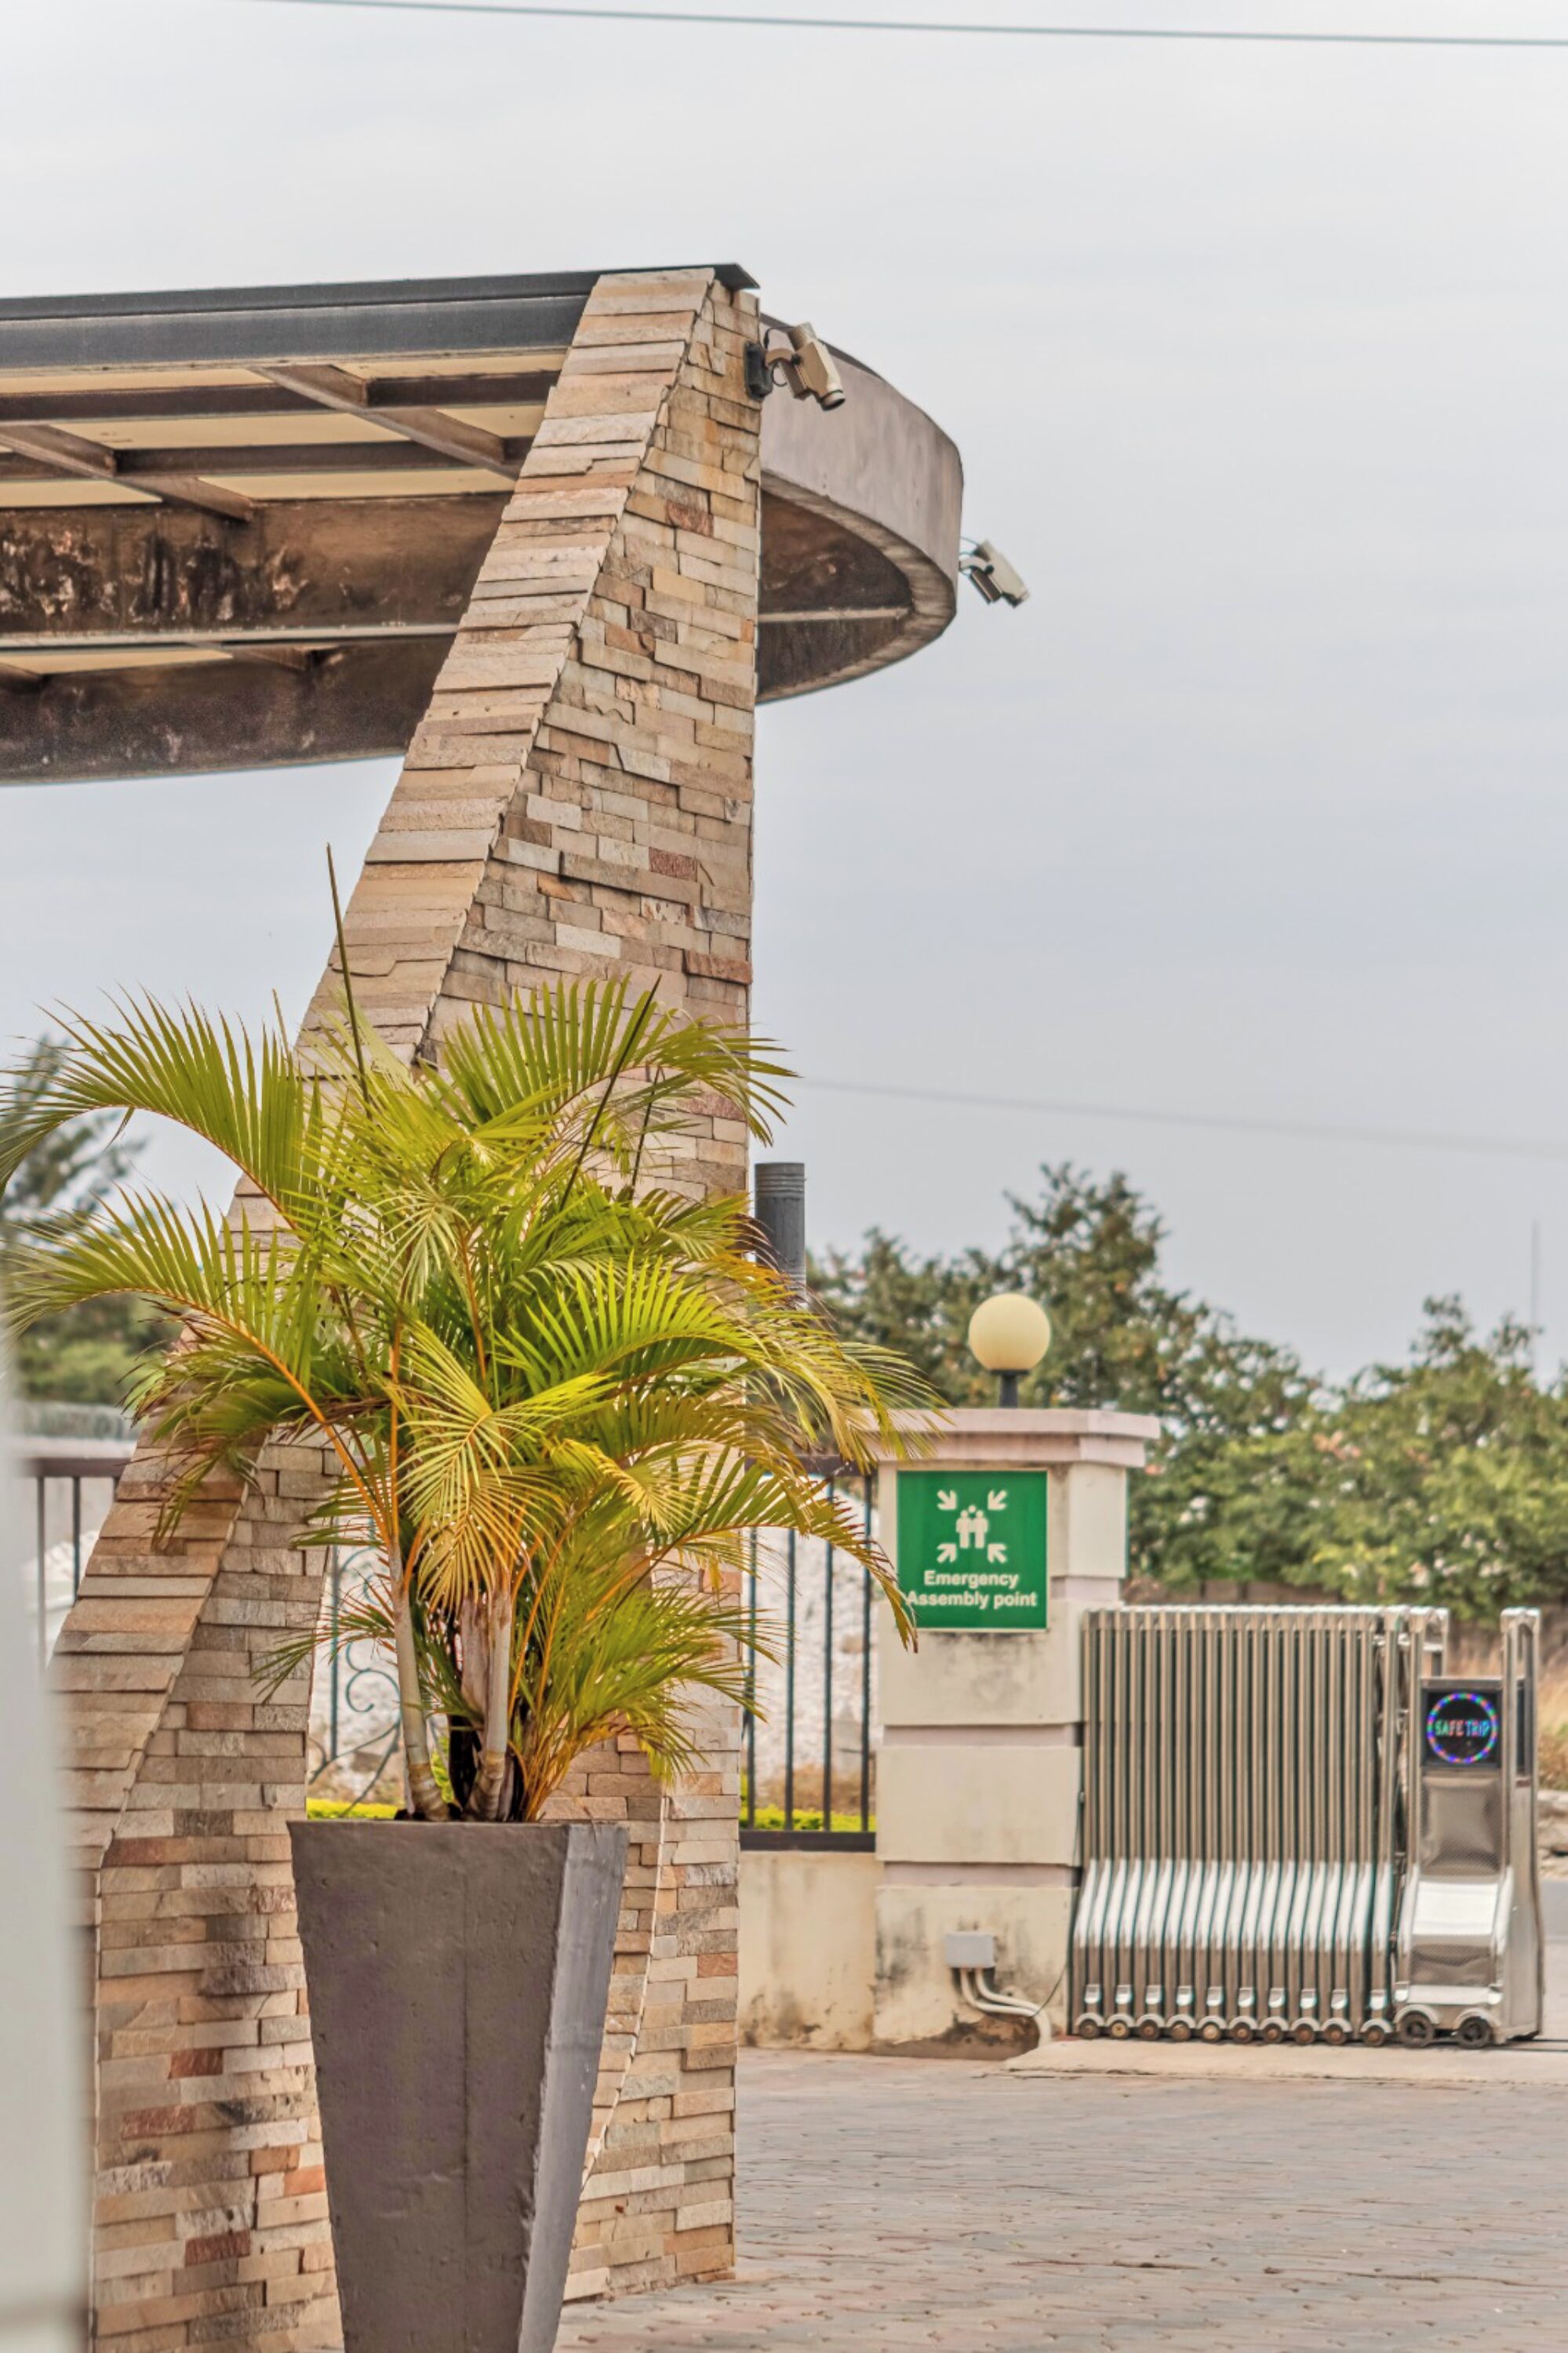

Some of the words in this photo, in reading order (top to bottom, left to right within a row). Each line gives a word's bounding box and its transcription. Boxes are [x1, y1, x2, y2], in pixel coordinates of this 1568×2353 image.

[924, 1570, 1019, 1588] Emergency
[907, 1591, 989, 1609] Assembly
[994, 1591, 1037, 1609] point
[1435, 1719, 1464, 1737] SAFE
[1465, 1719, 1490, 1737] TRIP
